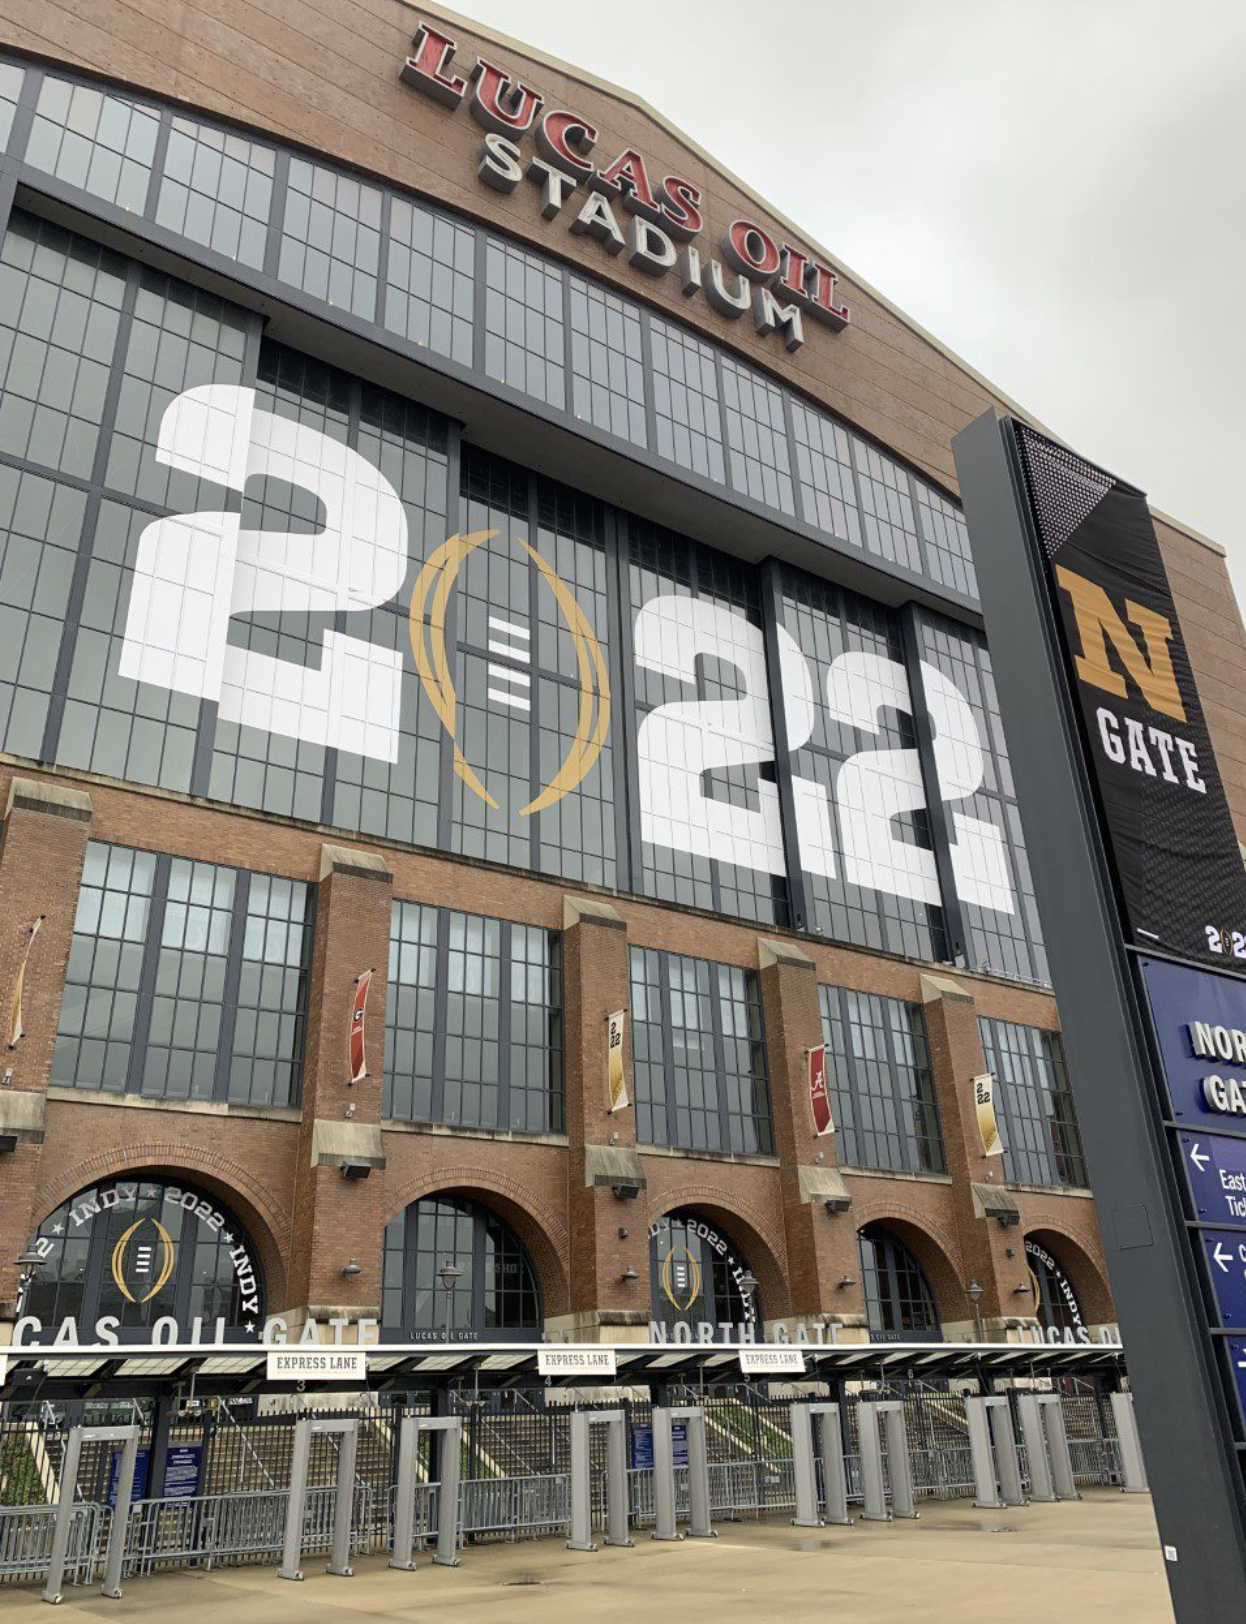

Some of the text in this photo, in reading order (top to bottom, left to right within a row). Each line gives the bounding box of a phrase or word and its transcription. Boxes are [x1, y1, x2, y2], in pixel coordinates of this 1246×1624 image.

[400, 21, 850, 331] LUCAS OIL
[478, 133, 804, 351] STADIUM
[1055, 563, 1188, 724] N
[1096, 706, 1206, 795] GATE
[1203, 1074, 1246, 1114] GA
[69, 1186, 259, 1314] INDY 2022 INDY
[687, 1219, 728, 1256] 2022
[1024, 1240, 1082, 1325] 2022 INDY
[262, 1317, 379, 1346] GATE
[410, 1332, 479, 1340] LUCAS OL GATE
[650, 1320, 843, 1345] NORTH GATE
[277, 1357, 357, 1369] EXPRESS LANE
[545, 1354, 610, 1366] EXPRESS LANE
[745, 1353, 799, 1365] EXPRESS LANE
